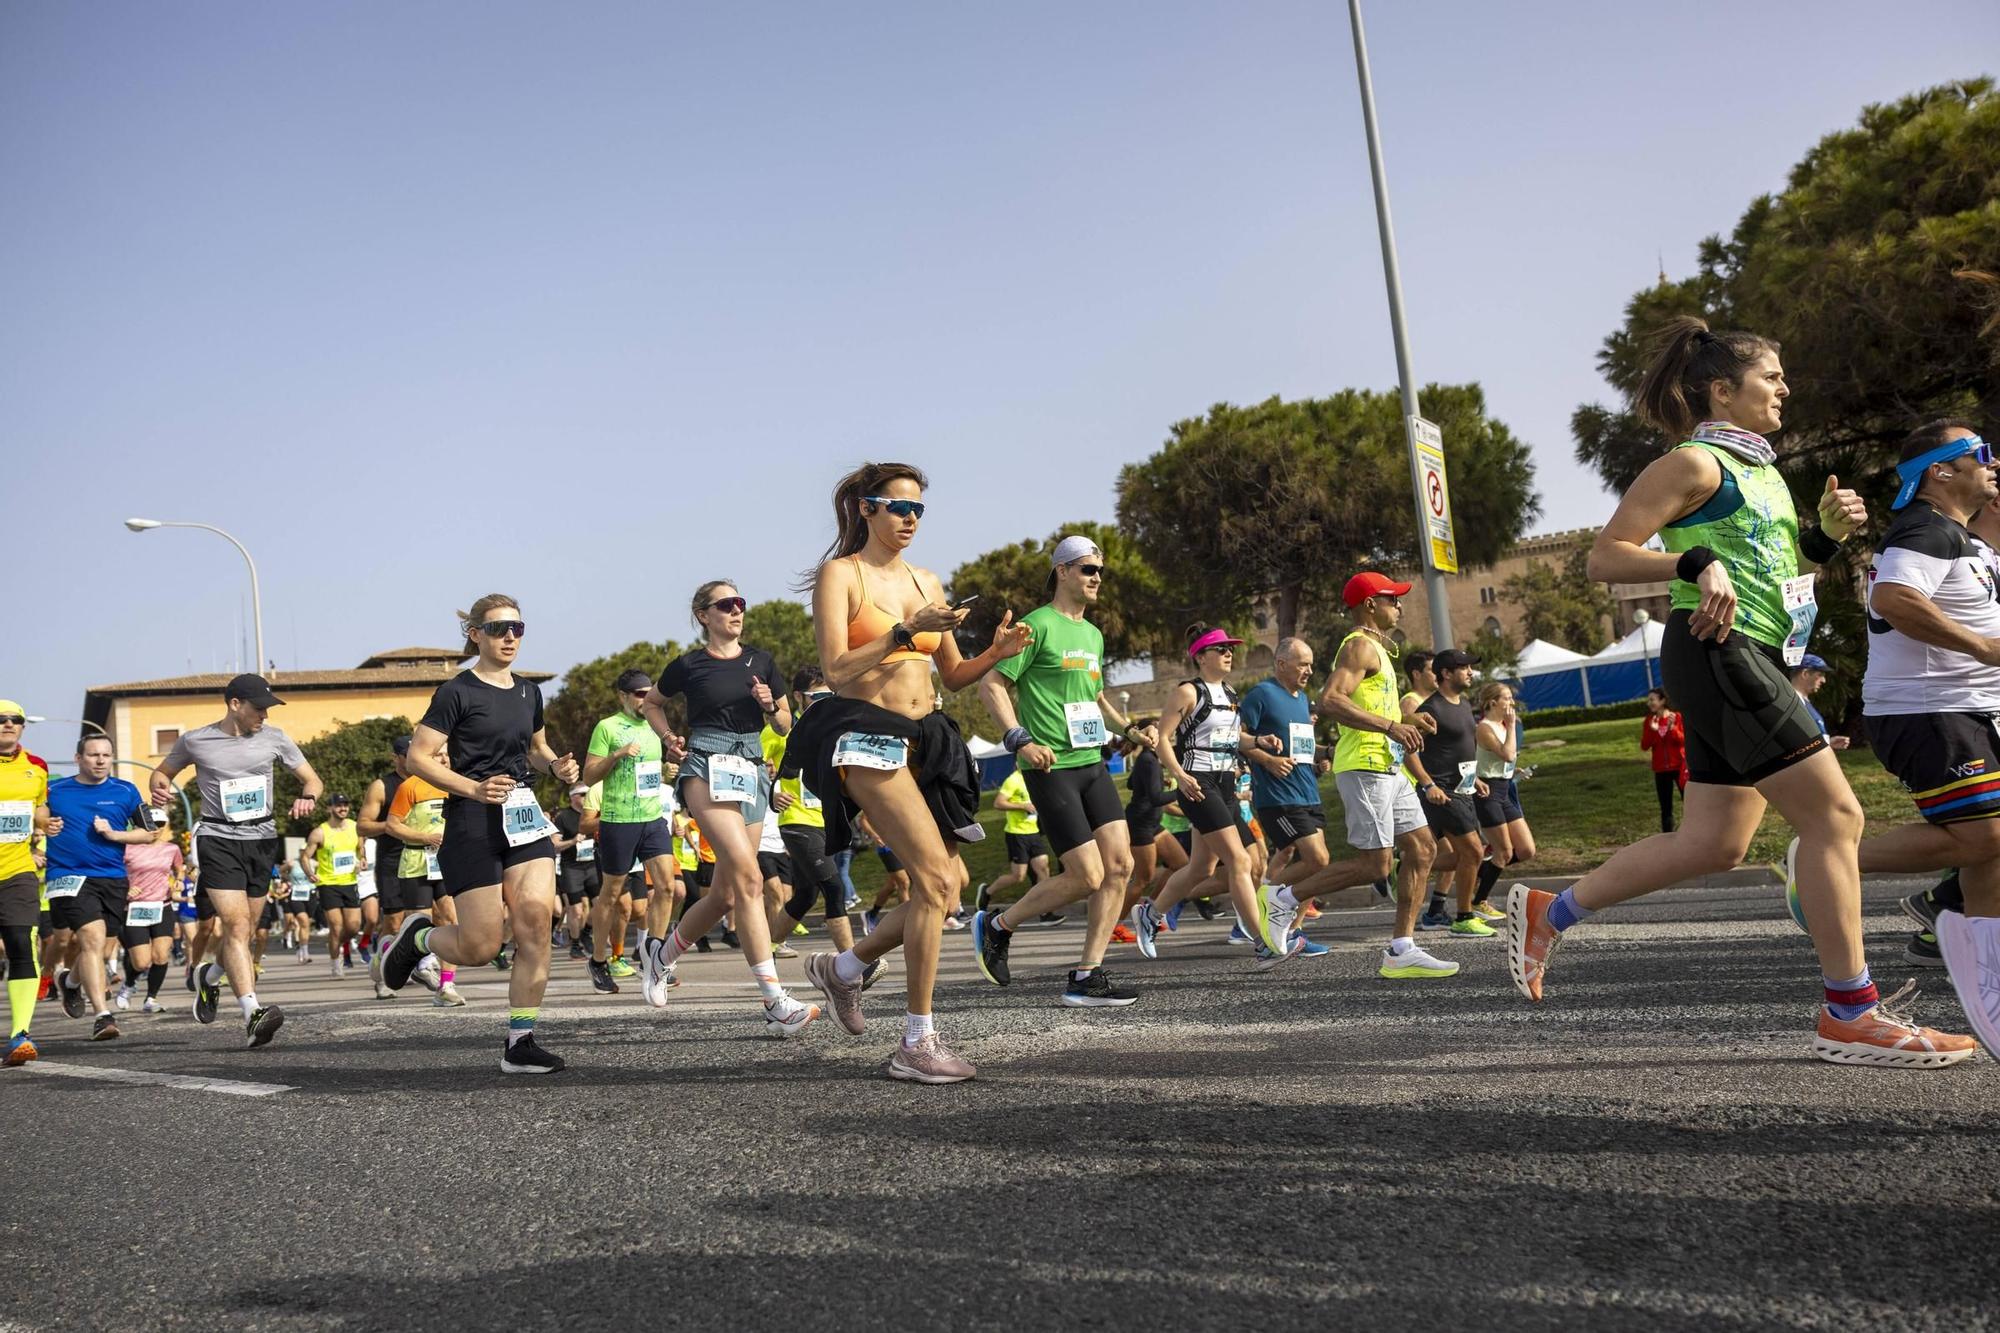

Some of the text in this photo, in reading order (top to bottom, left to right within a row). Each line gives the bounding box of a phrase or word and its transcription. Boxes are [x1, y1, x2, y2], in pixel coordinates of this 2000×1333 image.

[1082, 721, 1098, 735] 627
[645, 774, 659, 785] 385
[728, 773, 745, 787] 72
[237, 792, 257, 806] 464
[2, 816, 23, 828] 790
[515, 808, 533, 825] 100
